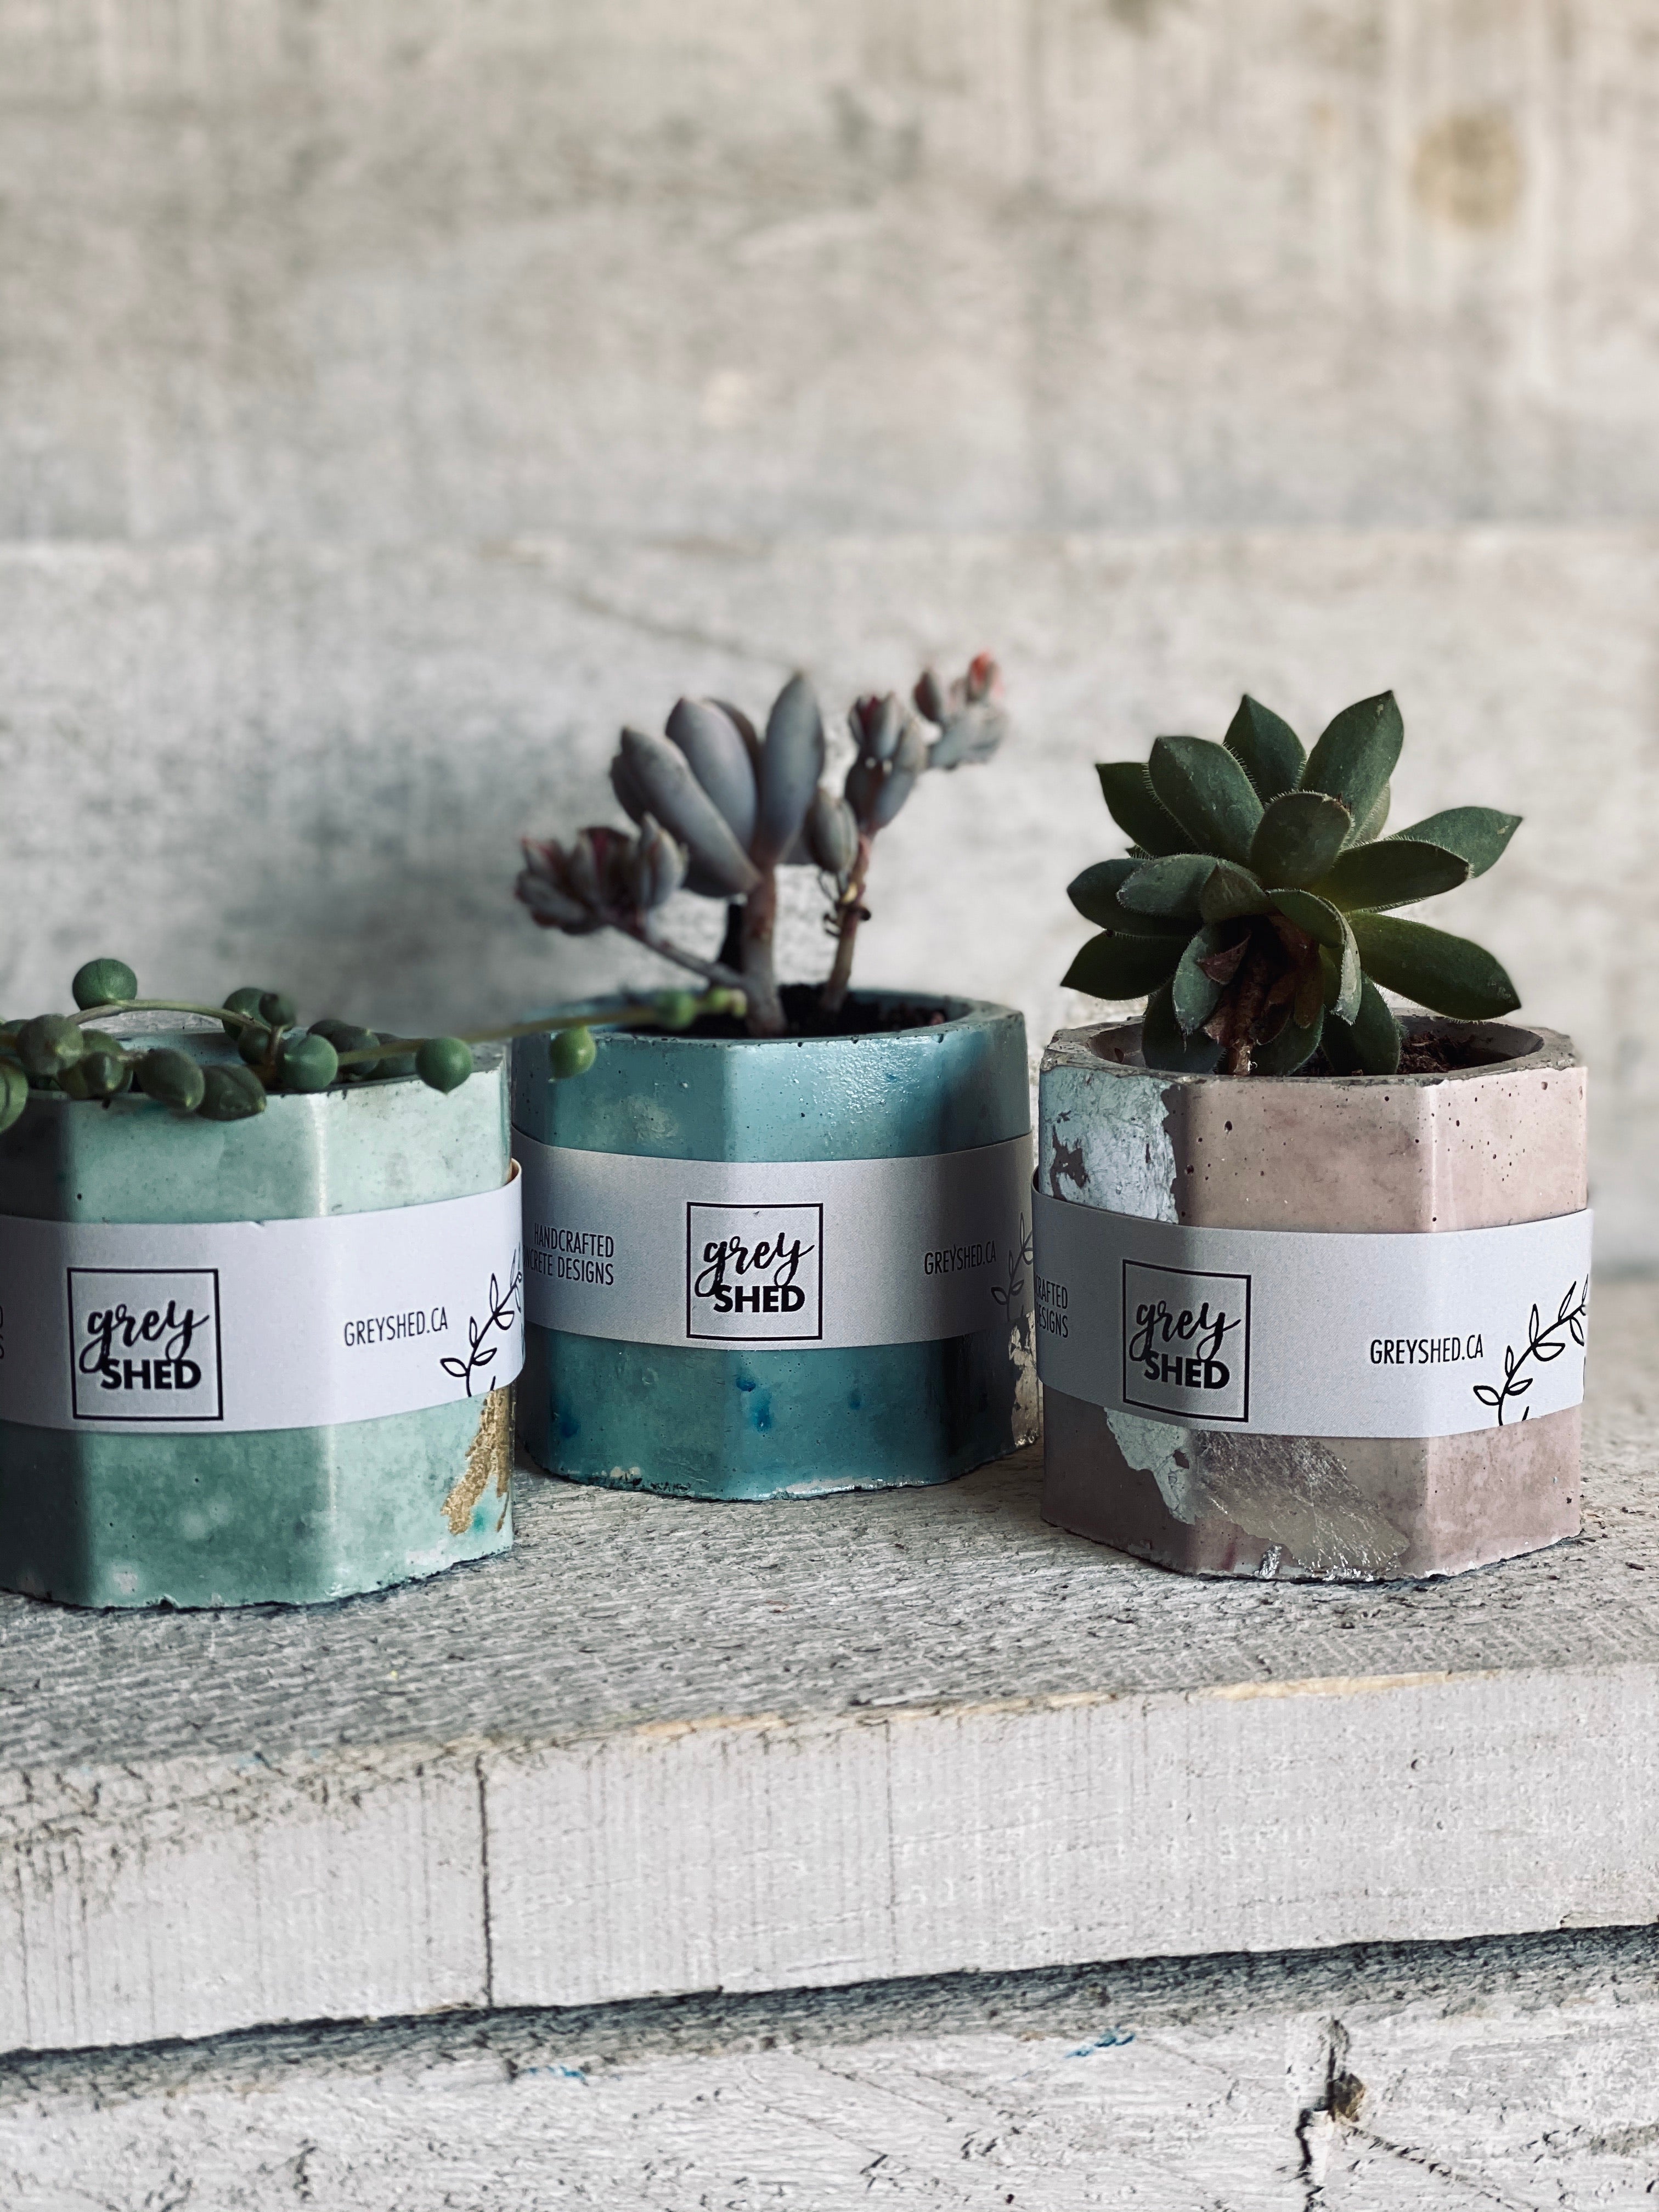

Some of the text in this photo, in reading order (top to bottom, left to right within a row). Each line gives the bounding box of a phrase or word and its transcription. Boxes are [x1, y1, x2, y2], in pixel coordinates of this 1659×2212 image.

[534, 1222, 614, 1258] HANDCRAFTED
[924, 1240, 996, 1275] GREYSHED.CA
[523, 1244, 614, 1285] ONCRETE DESIGNS
[695, 1232, 815, 1297] grey
[713, 1284, 805, 1313] SHED
[79, 1300, 210, 1373] grey
[344, 1307, 448, 1346] GREYSHED.CA
[1129, 1300, 1242, 1362] grey
[1370, 1334, 1483, 1364] GREYSHED.CA
[100, 1358, 201, 1389] SHED
[1143, 1349, 1230, 1390] SHED
